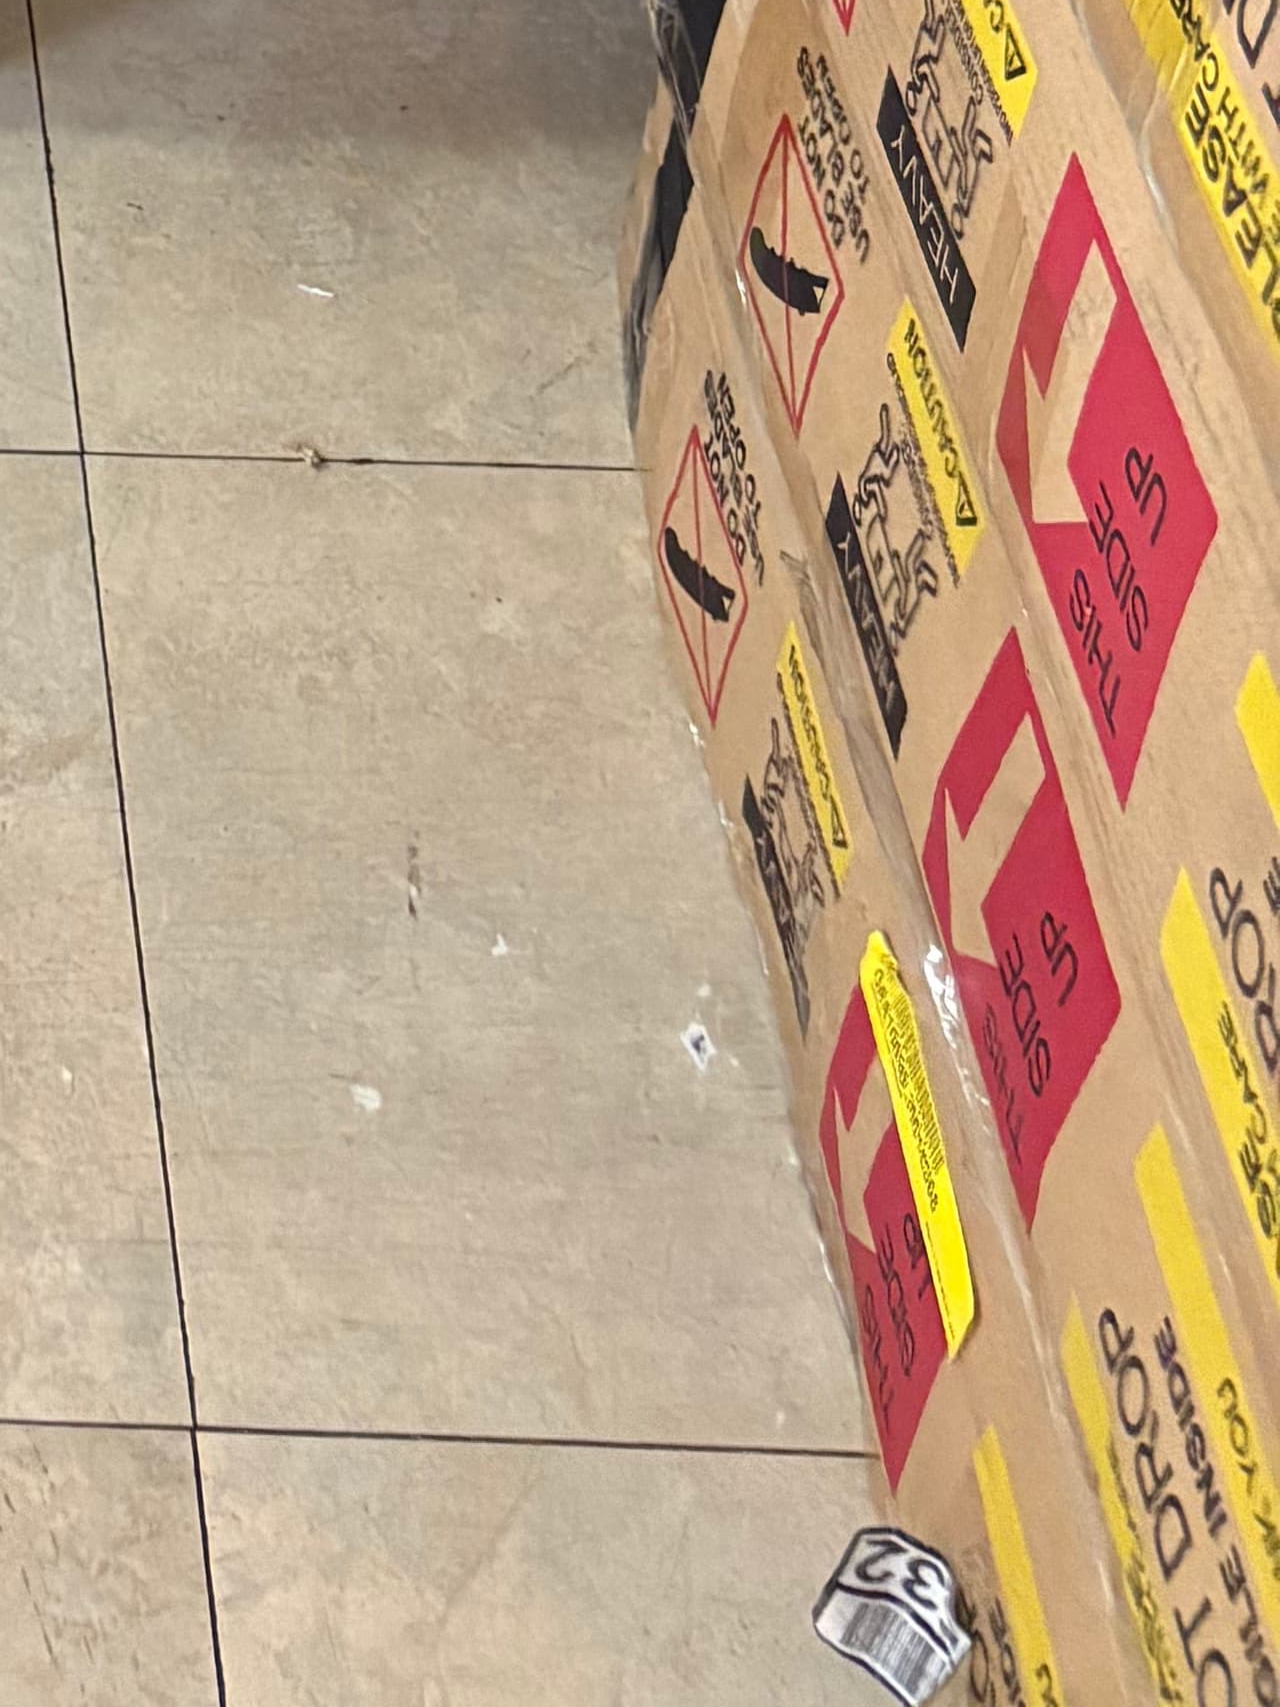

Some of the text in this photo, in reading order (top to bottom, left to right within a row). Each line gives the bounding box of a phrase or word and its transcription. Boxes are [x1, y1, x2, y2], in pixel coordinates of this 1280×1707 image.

[890, 124, 958, 305] HEAVY
[903, 318, 959, 479] CAUTION
[1089, 480, 1148, 652] SIDE
[1125, 447, 1168, 547] UP
[1069, 568, 1121, 738] THIS
[998, 931, 1051, 1098] SIDE
[1040, 911, 1079, 1008] UP
[1099, 1307, 1192, 1584] DROP
[1154, 1315, 1228, 1539] INSIDE
